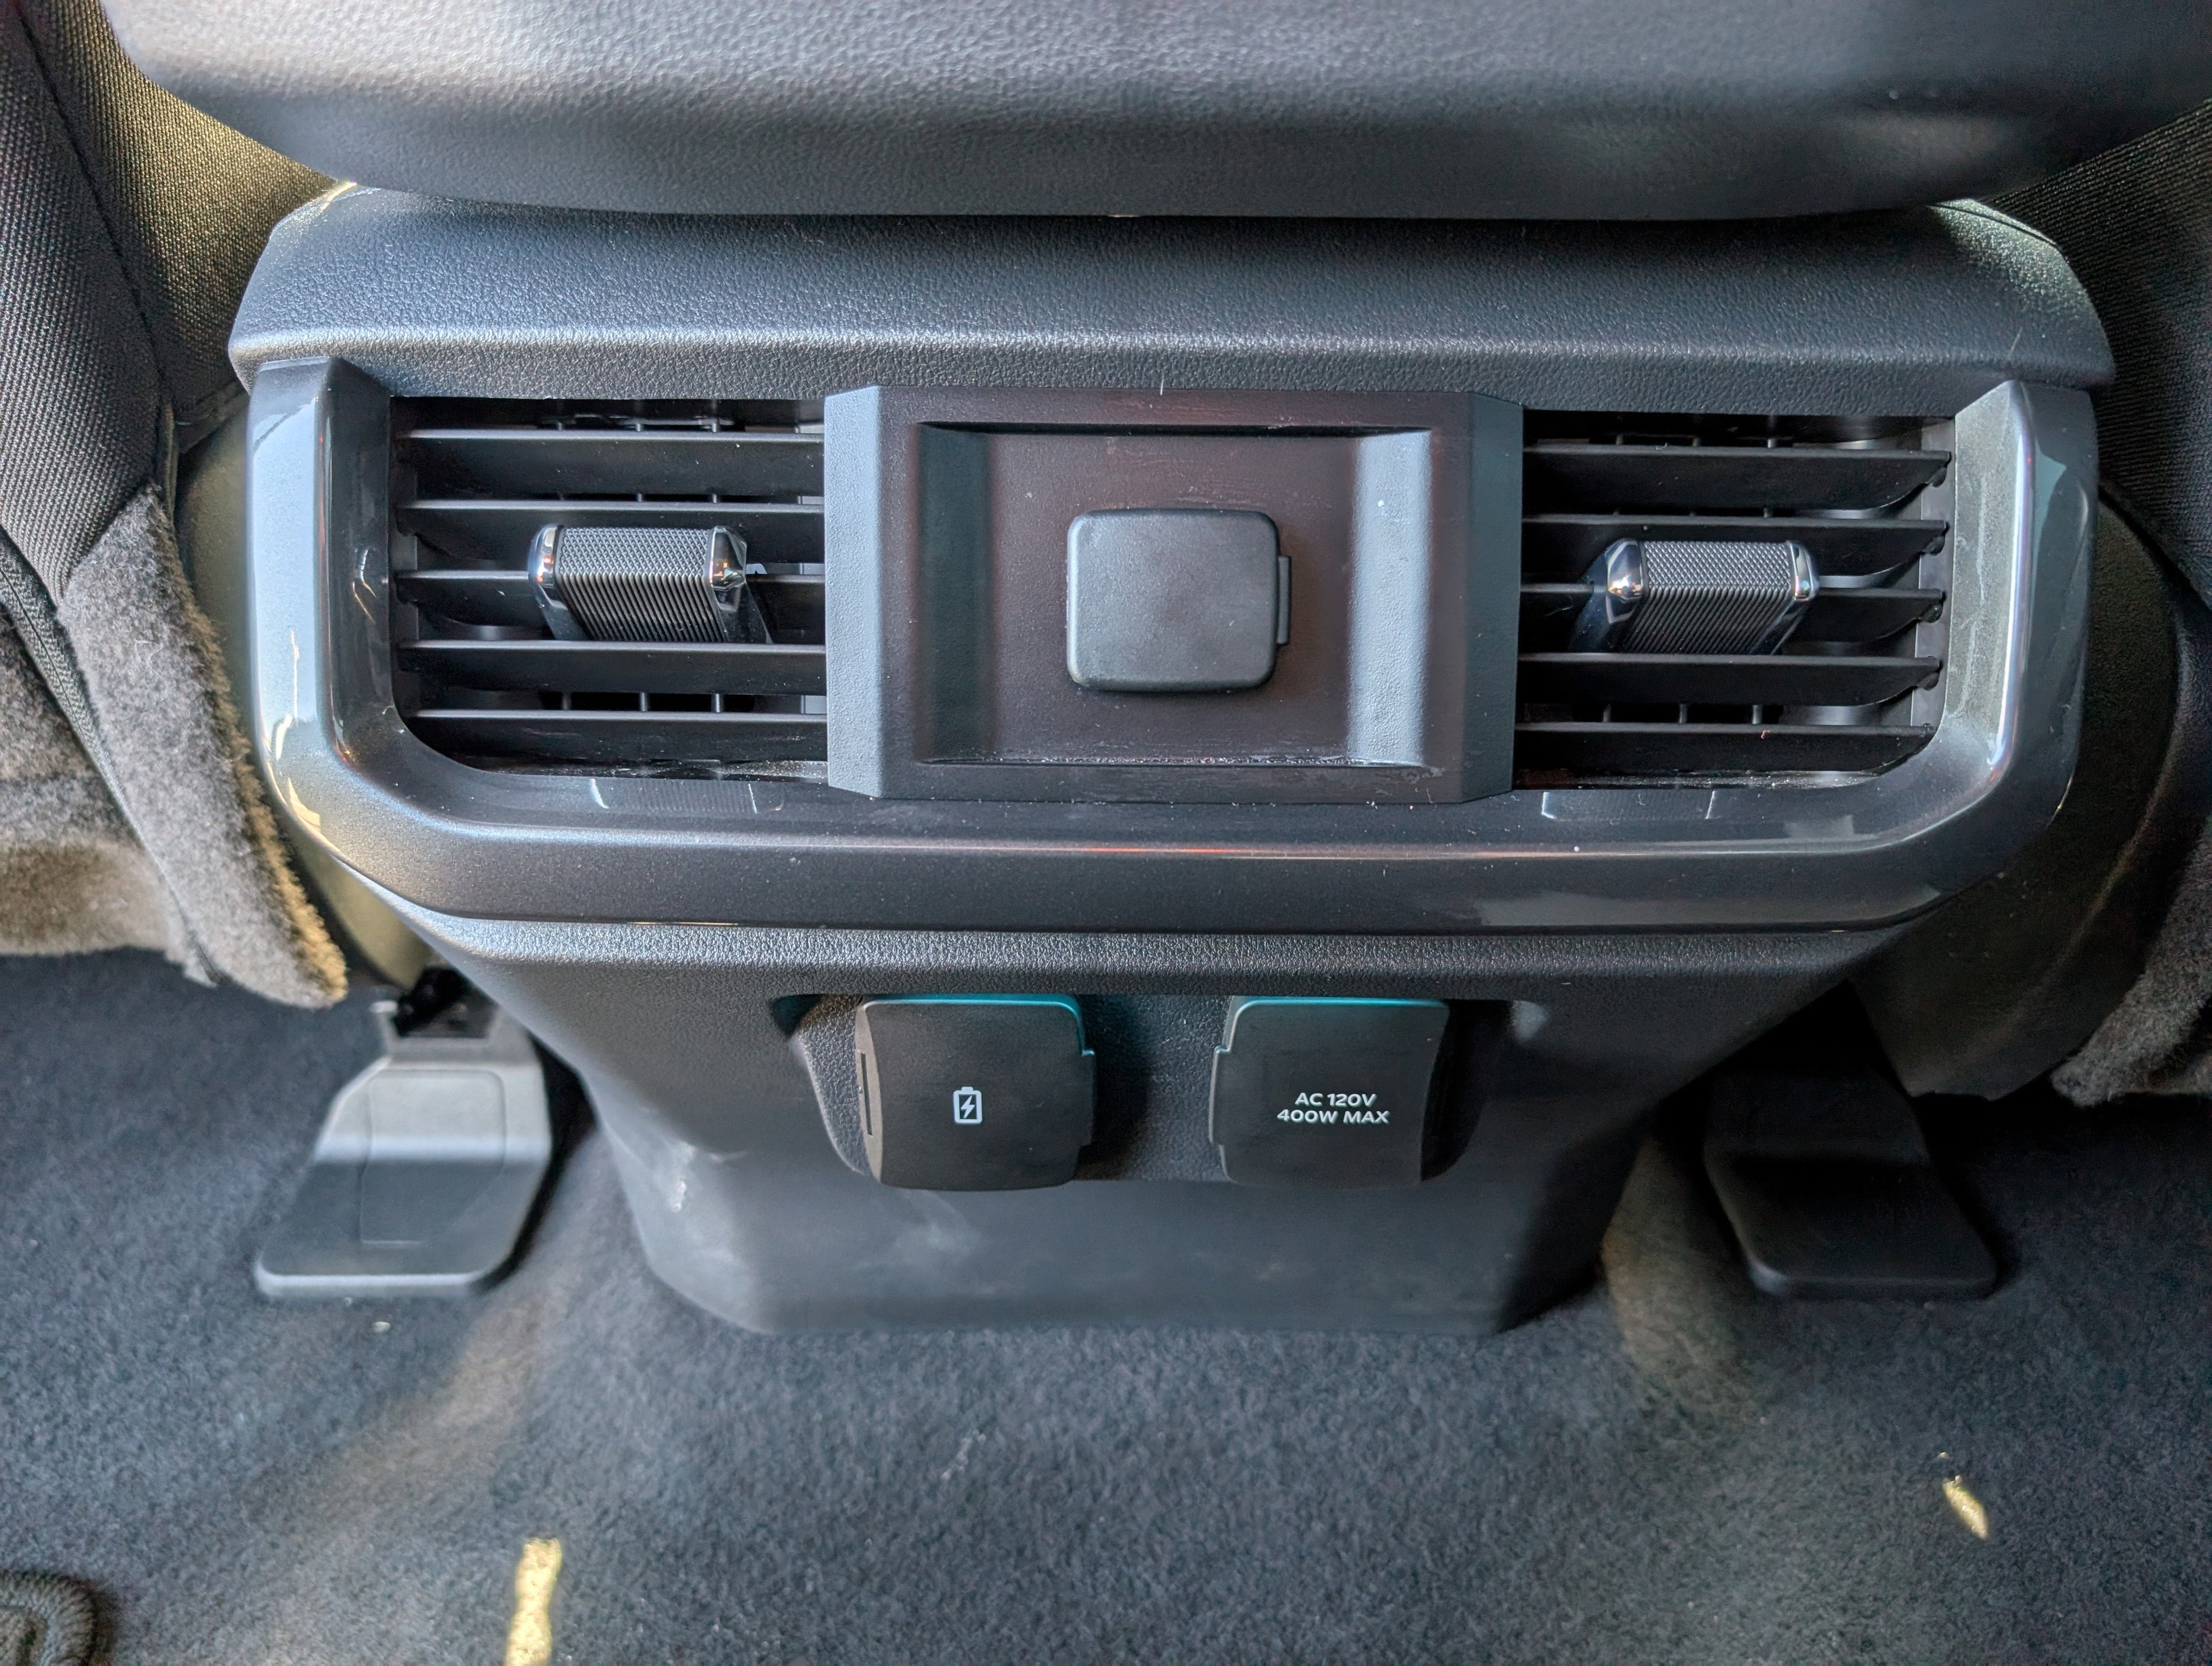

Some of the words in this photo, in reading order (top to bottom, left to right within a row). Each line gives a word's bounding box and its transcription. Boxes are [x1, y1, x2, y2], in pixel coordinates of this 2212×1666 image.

[1295, 1093, 1323, 1106] AC
[1327, 1094, 1377, 1107] 120V
[1277, 1109, 1338, 1123] 400W
[1343, 1111, 1389, 1123] MAX
